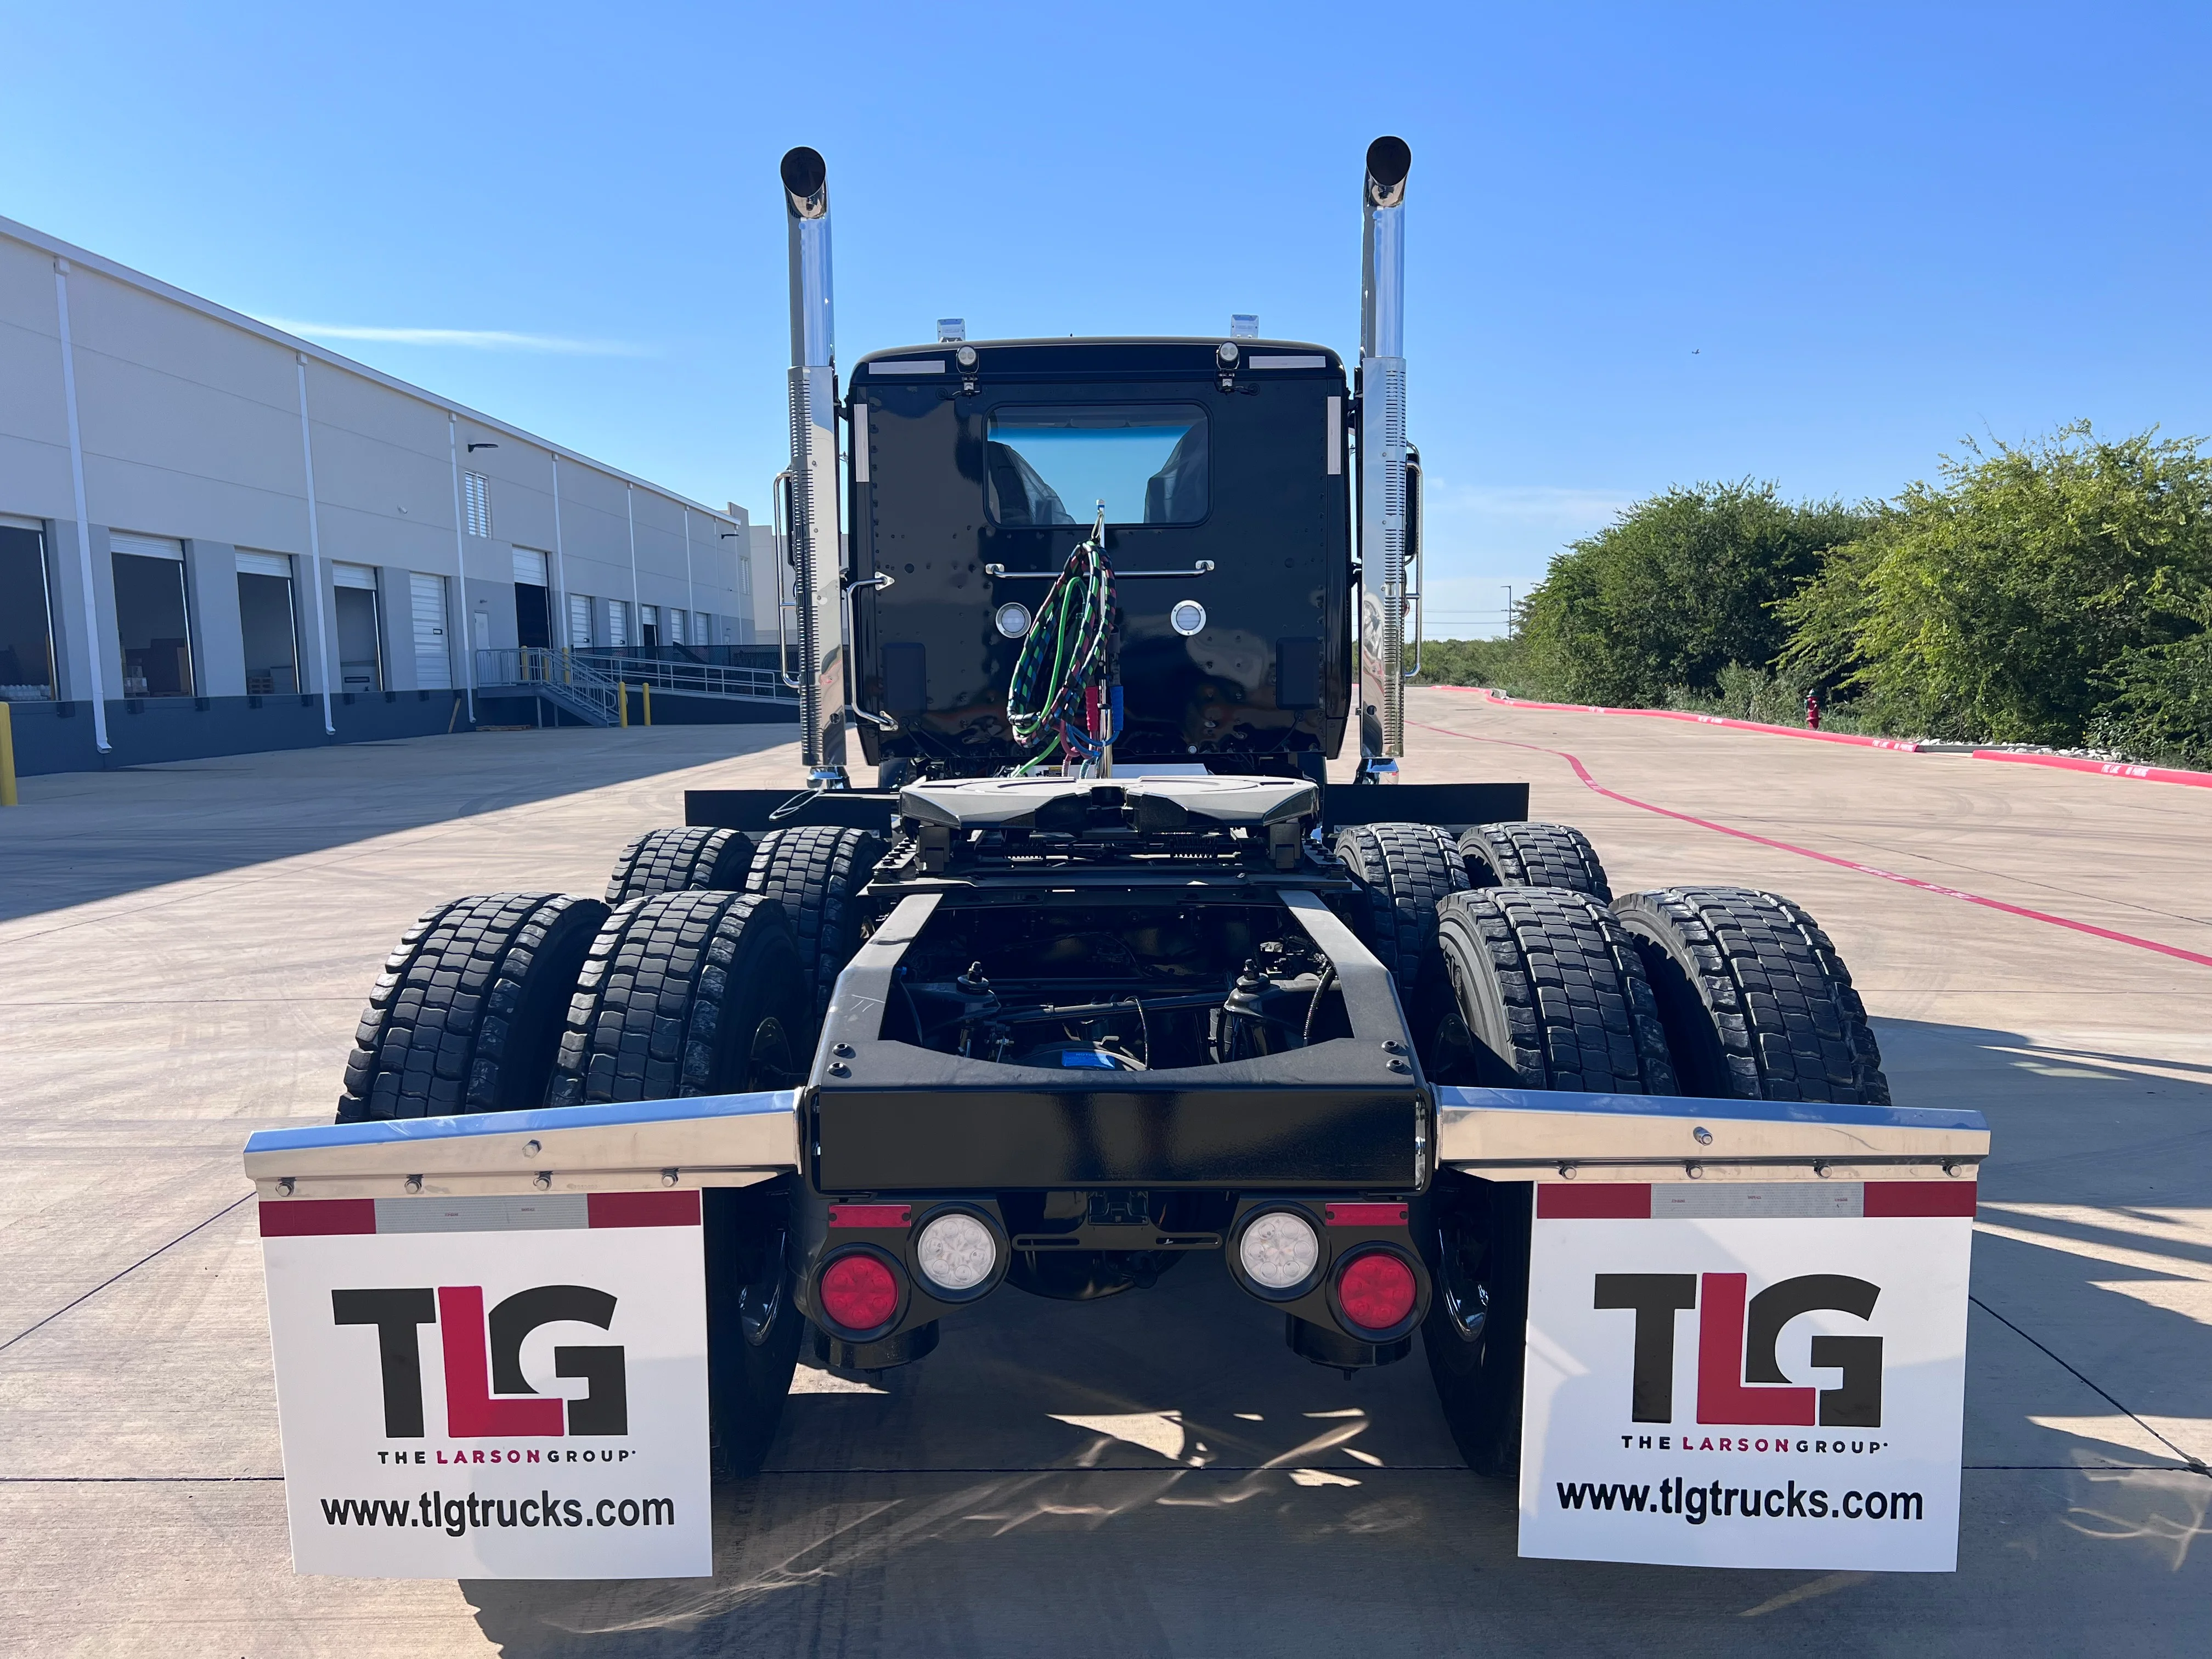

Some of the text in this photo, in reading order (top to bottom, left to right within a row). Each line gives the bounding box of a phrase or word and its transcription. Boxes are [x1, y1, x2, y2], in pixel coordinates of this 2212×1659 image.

[331, 1285, 628, 1438] TLG
[1594, 1273, 1883, 1427] TLG
[378, 1452, 425, 1464] THE
[437, 1450, 539, 1464] LARSON
[1622, 1436, 1670, 1449] THE
[1683, 1437, 1788, 1452] LARSON
[320, 1491, 674, 1537] www.tlgtrucks.com
[1556, 1477, 1922, 1525] www.tlgtrucks.com
